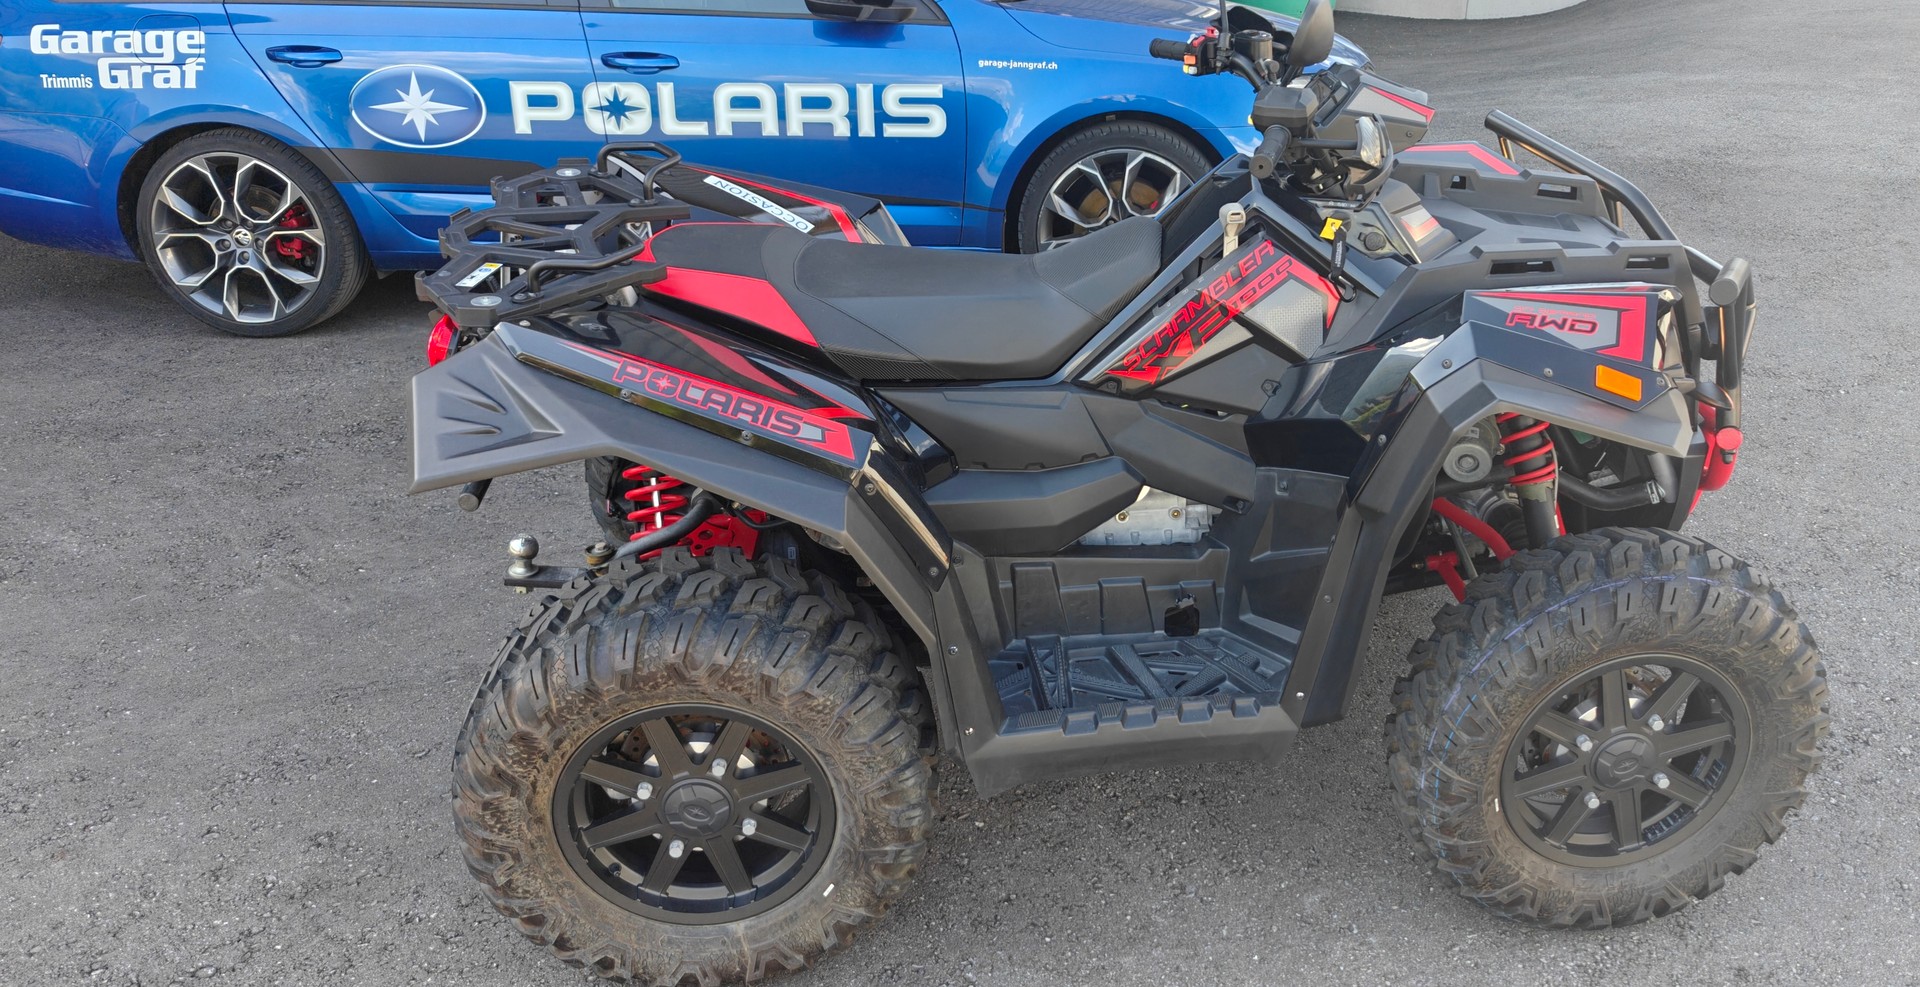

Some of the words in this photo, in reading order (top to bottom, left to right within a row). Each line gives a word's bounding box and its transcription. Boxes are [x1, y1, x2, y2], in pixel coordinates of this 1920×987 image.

[30, 24, 206, 64] Garage
[978, 60, 1058, 70] garage-janngraf.ch
[40, 74, 93, 88] Trimmis
[97, 57, 206, 89] Graf
[509, 81, 948, 138] POLARIS
[714, 180, 809, 231] OCCASION
[1123, 240, 1275, 368] SCRAMBLER
[1229, 258, 1294, 312] 1000
[1505, 312, 1599, 336] AWD
[612, 357, 804, 436] POLARIS
